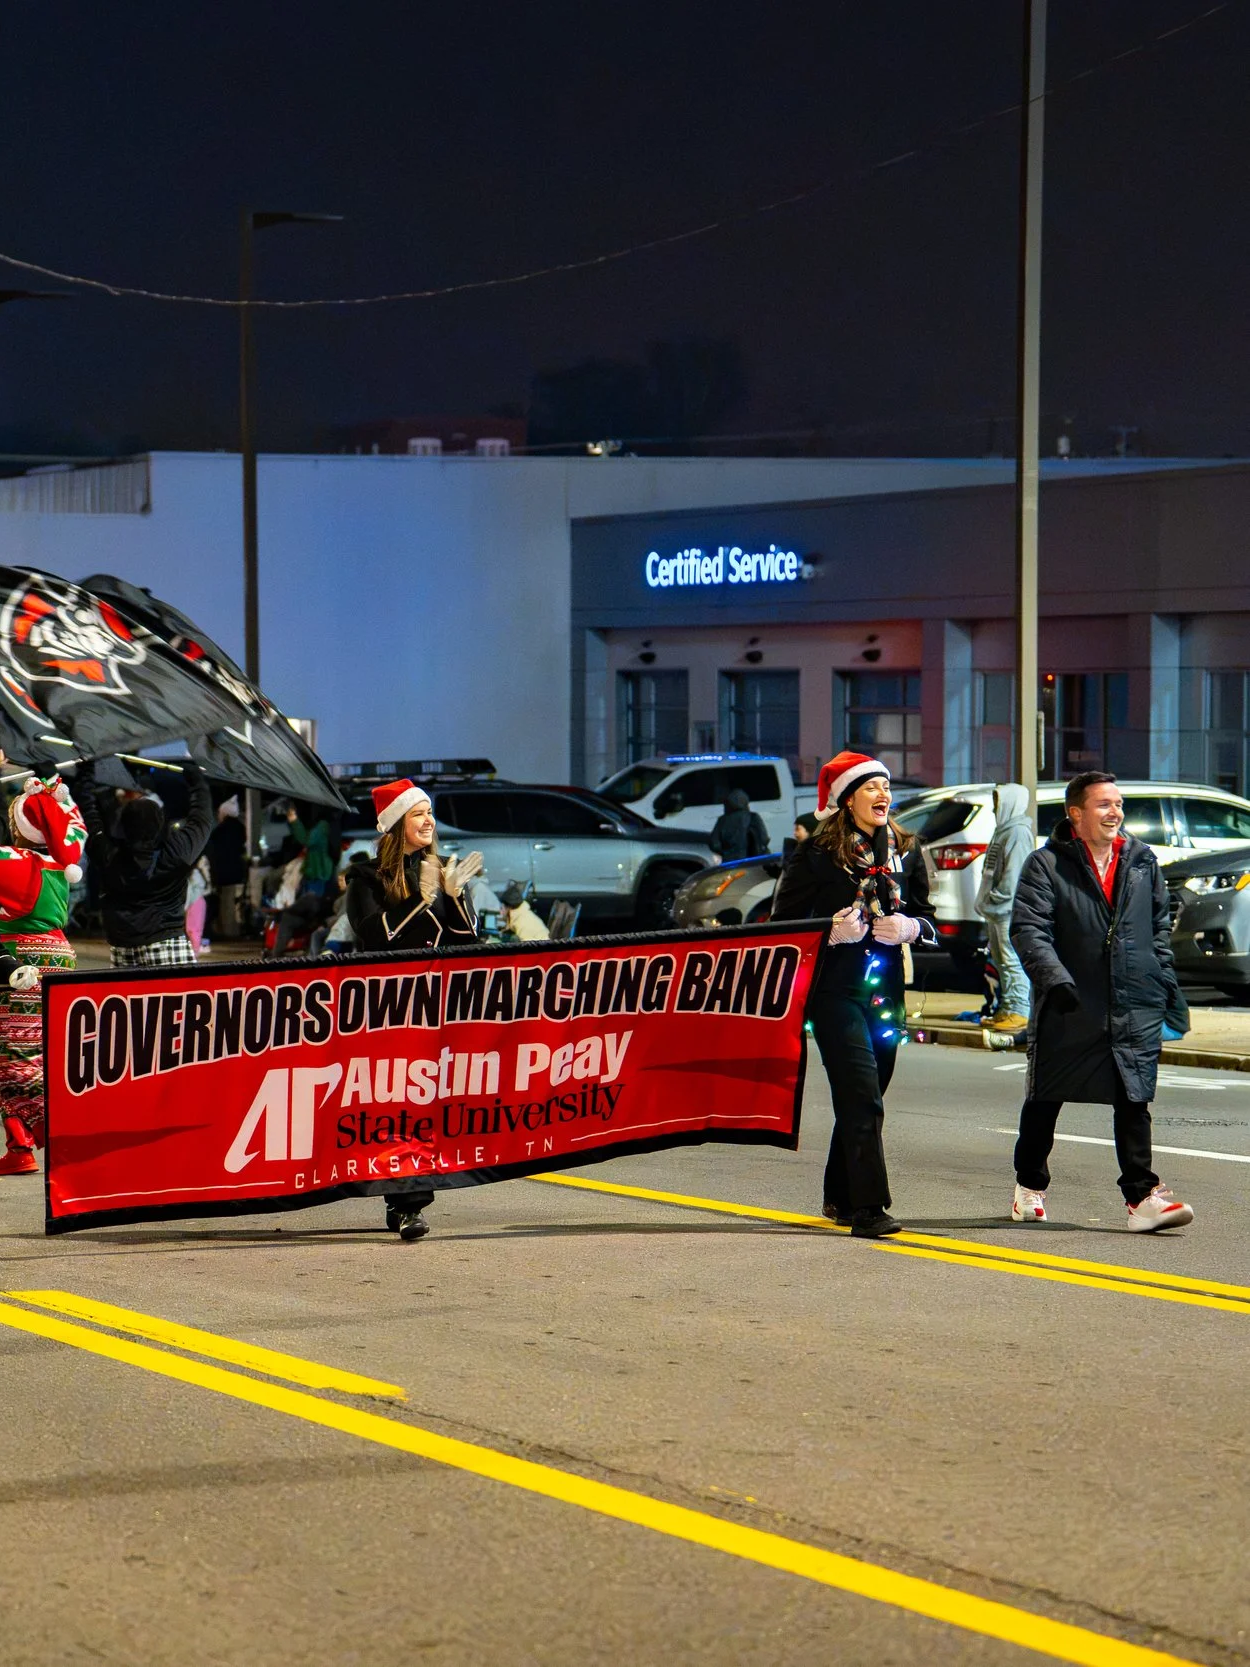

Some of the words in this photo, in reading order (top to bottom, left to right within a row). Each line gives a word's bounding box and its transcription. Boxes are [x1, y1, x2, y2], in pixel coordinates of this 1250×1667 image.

[645, 546, 724, 587] Certified
[728, 544, 798, 583] Service
[65, 979, 334, 1097] GOVERNORS
[337, 971, 442, 1036] OWN
[445, 953, 676, 1026] MARCHING
[673, 945, 802, 1021] BAND
[341, 1046, 500, 1108] Austin
[515, 1030, 634, 1093] Peay
[336, 1105, 434, 1149] State
[442, 1082, 626, 1139] University
[525, 1136, 554, 1157] TN
